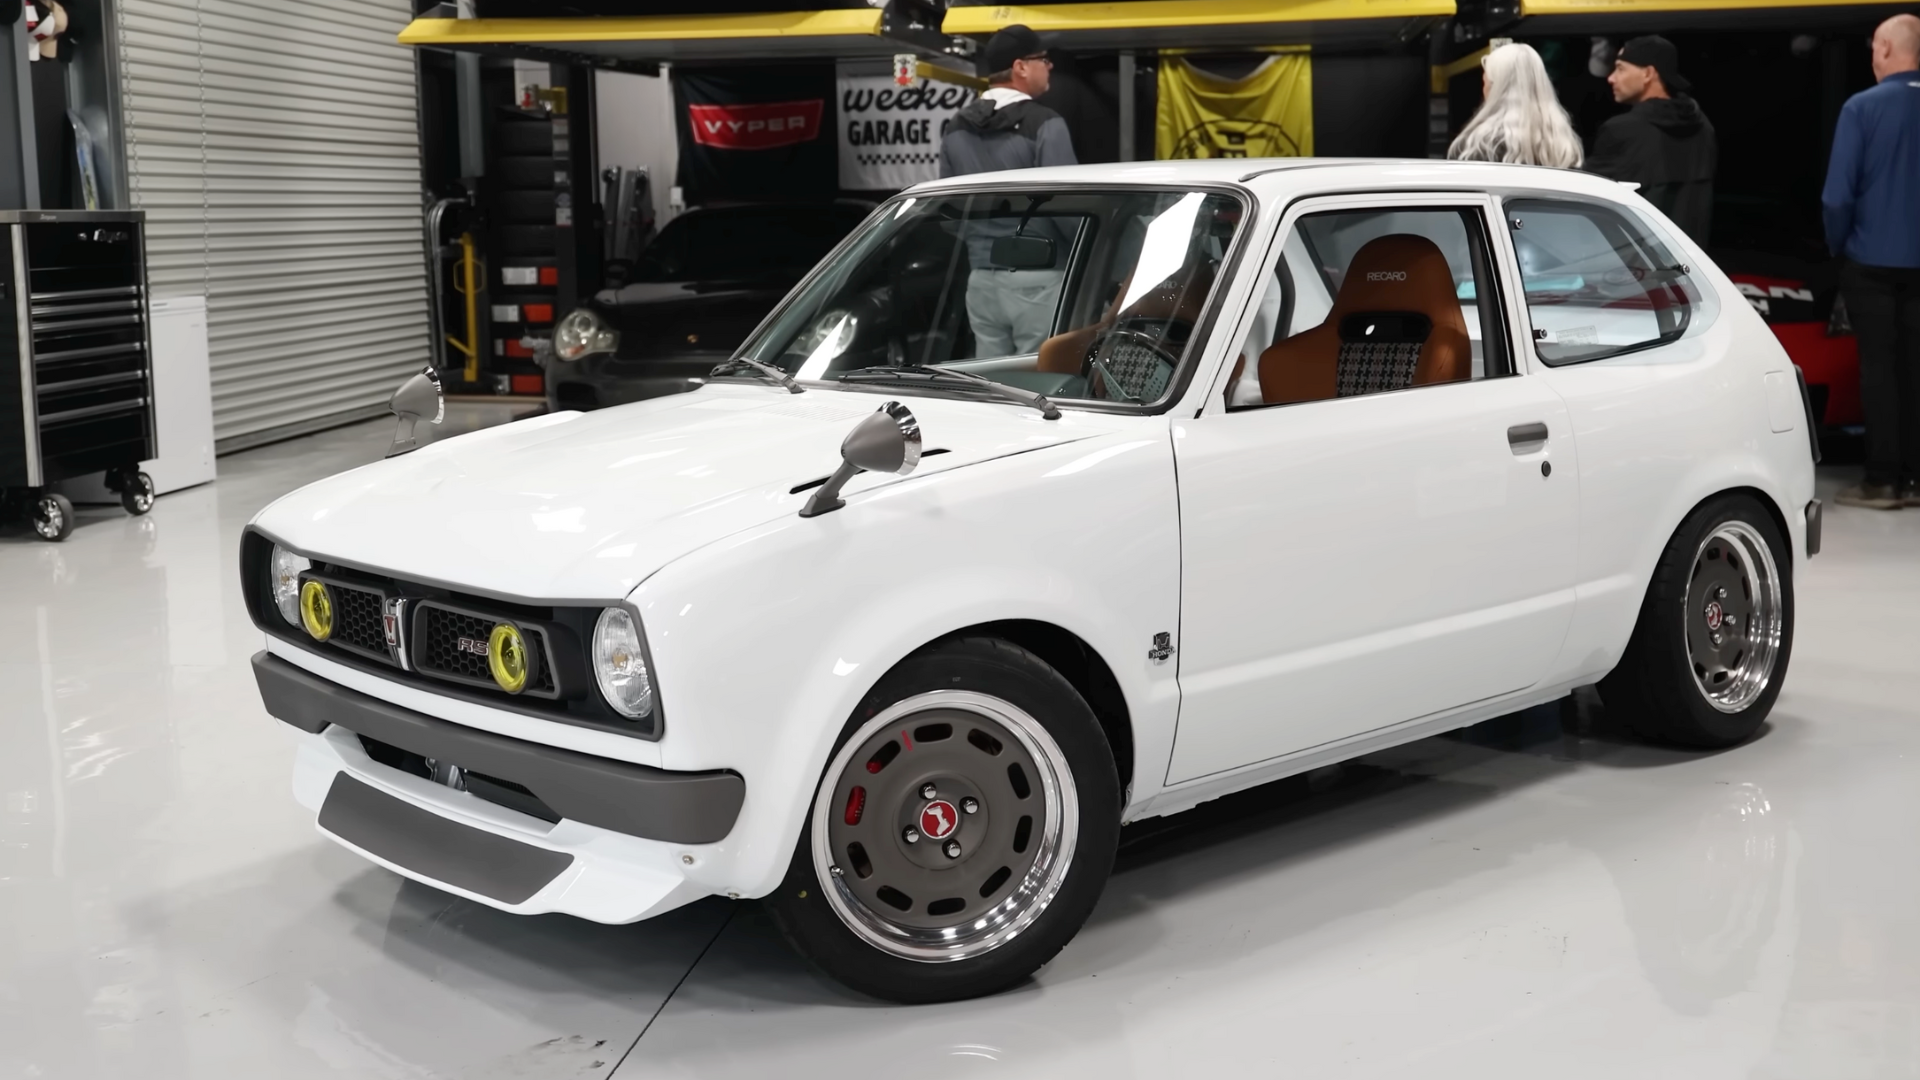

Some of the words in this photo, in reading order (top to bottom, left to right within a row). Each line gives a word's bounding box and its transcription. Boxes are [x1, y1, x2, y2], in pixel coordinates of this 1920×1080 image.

[704, 116, 805, 134] VYPER
[847, 119, 931, 146] GARAGE
[1366, 271, 1407, 281] RECARO
[457, 637, 489, 656] RS
